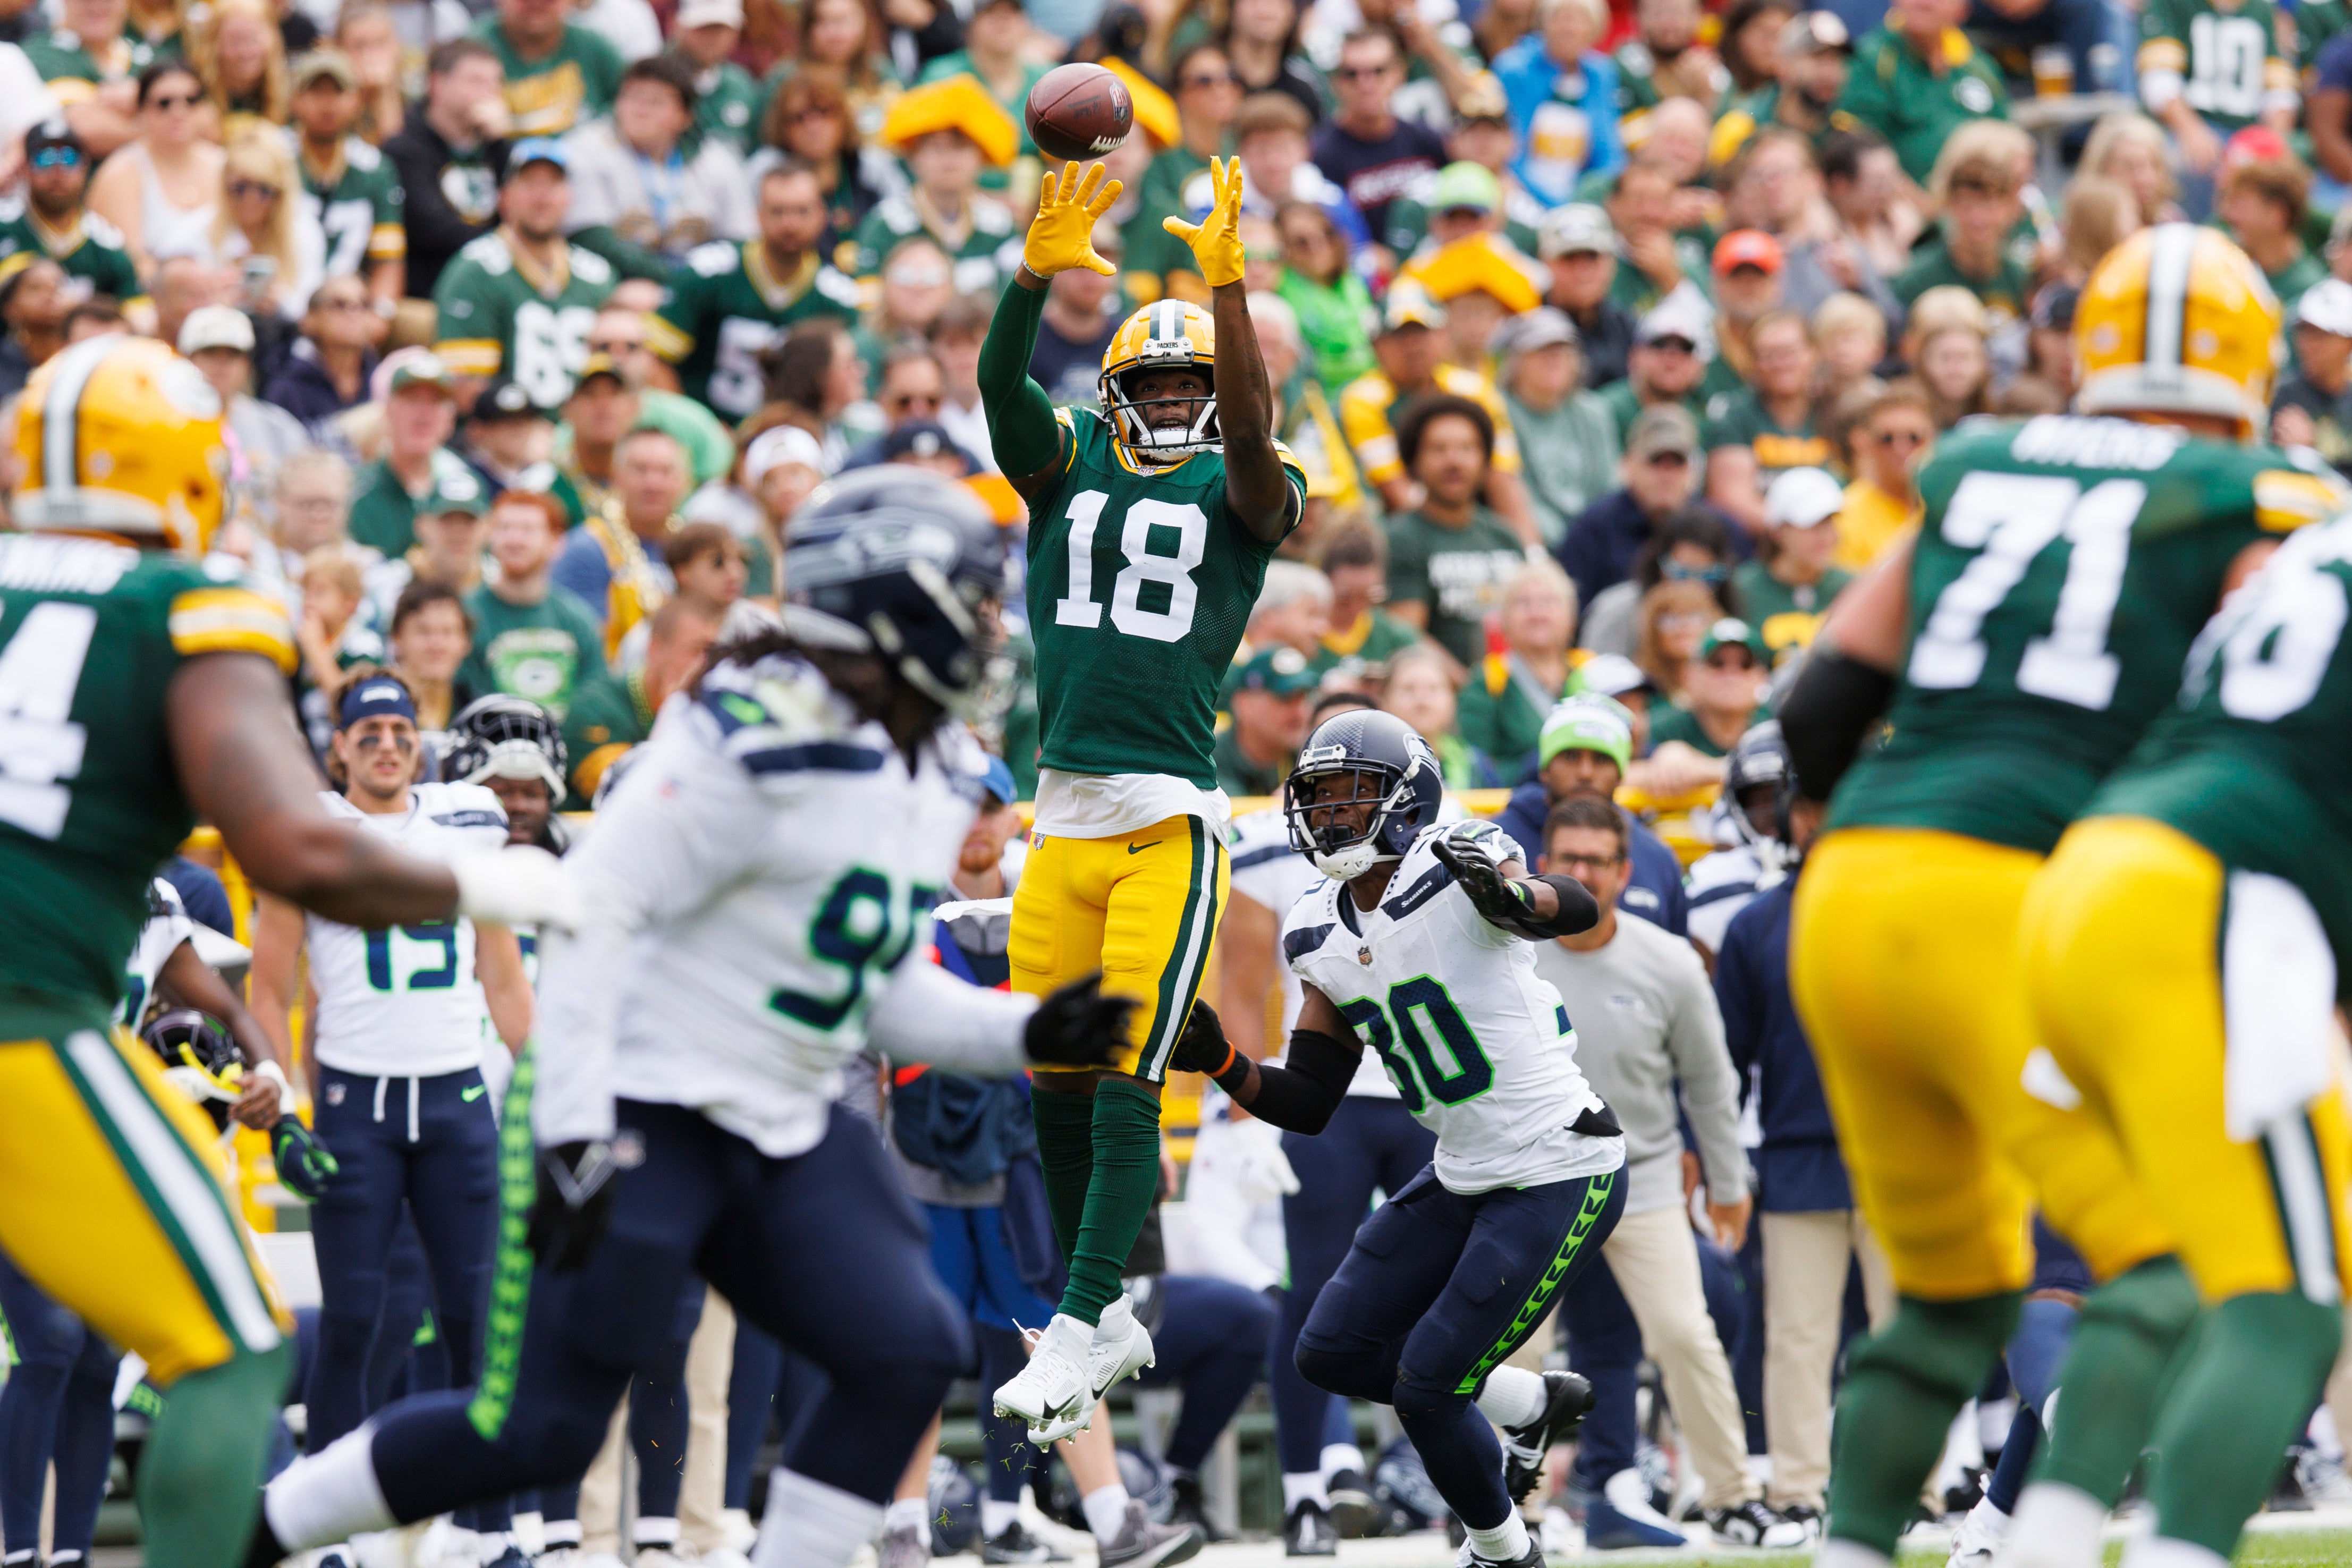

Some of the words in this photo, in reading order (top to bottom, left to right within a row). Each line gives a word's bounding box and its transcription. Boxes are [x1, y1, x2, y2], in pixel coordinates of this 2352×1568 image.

[2185, 12, 2266, 116] 10
[1056, 489, 1207, 642] 18
[1908, 470, 2147, 710] 71
[1401, 880, 1433, 908] SEAHAWKS
